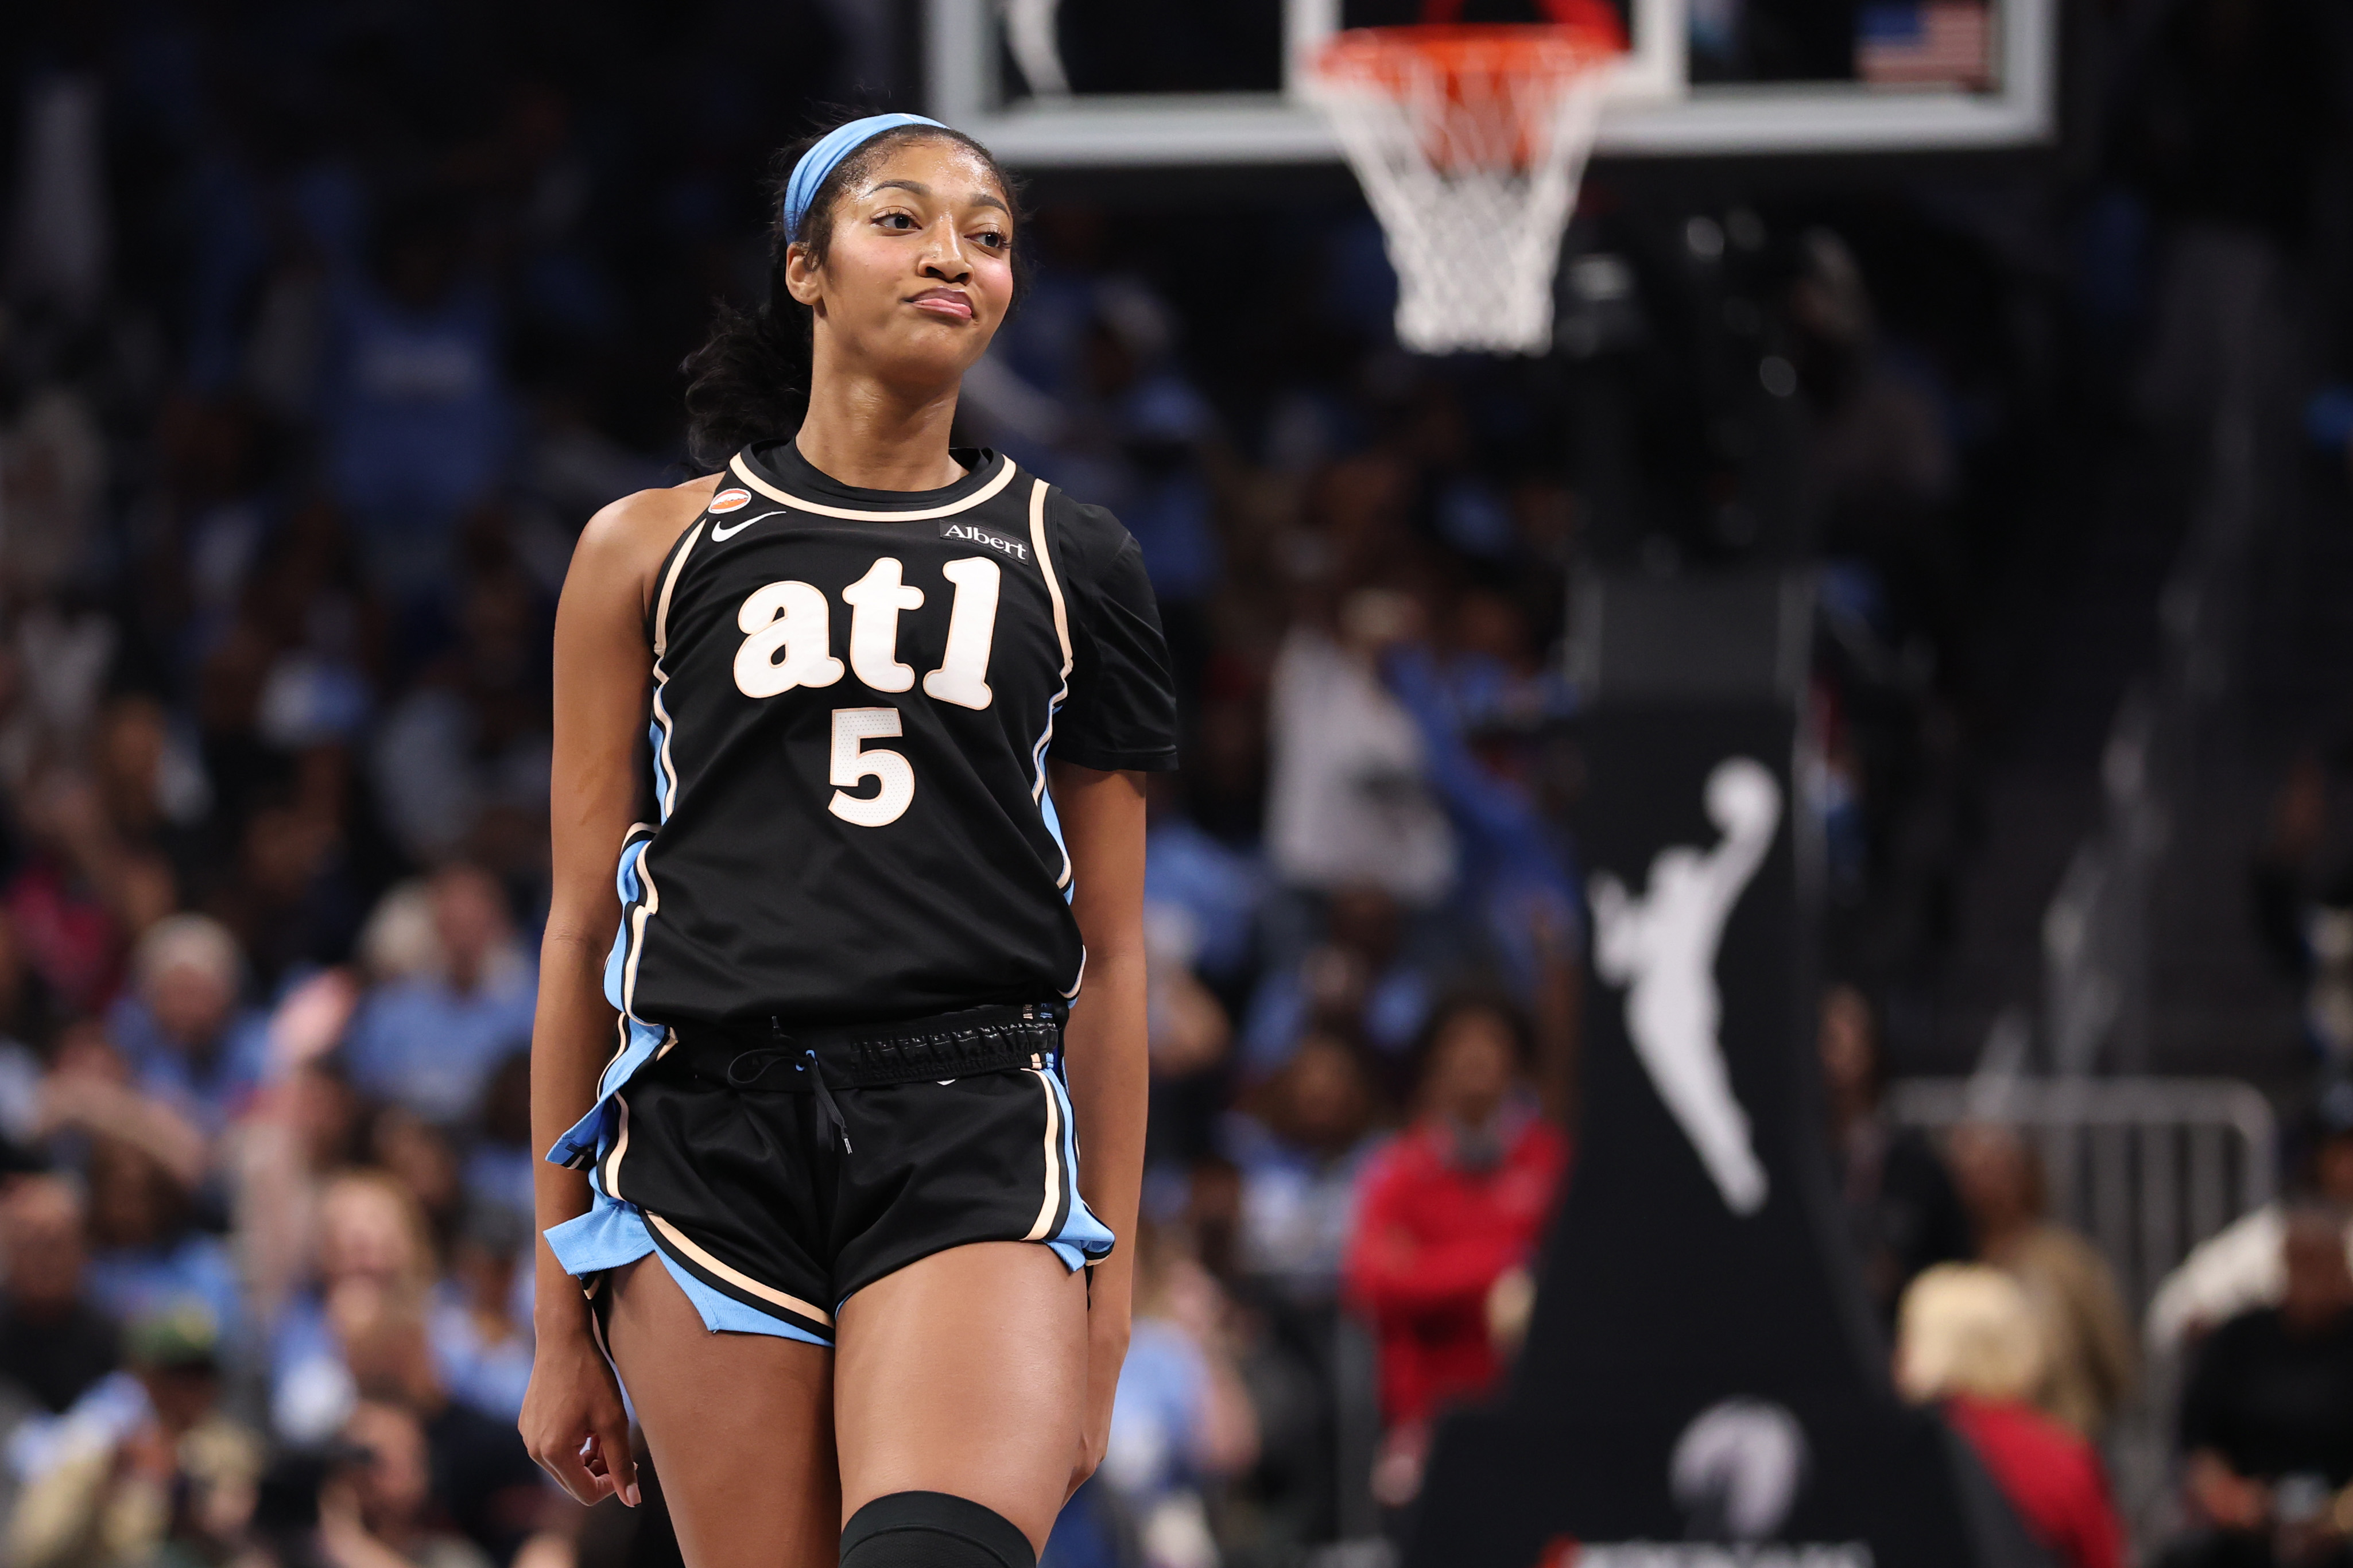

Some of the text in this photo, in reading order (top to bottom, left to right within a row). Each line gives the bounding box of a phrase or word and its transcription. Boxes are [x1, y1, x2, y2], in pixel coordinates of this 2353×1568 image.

[943, 524, 1027, 560] Albert
[733, 556, 1001, 711] atl
[828, 707, 915, 828] 5
